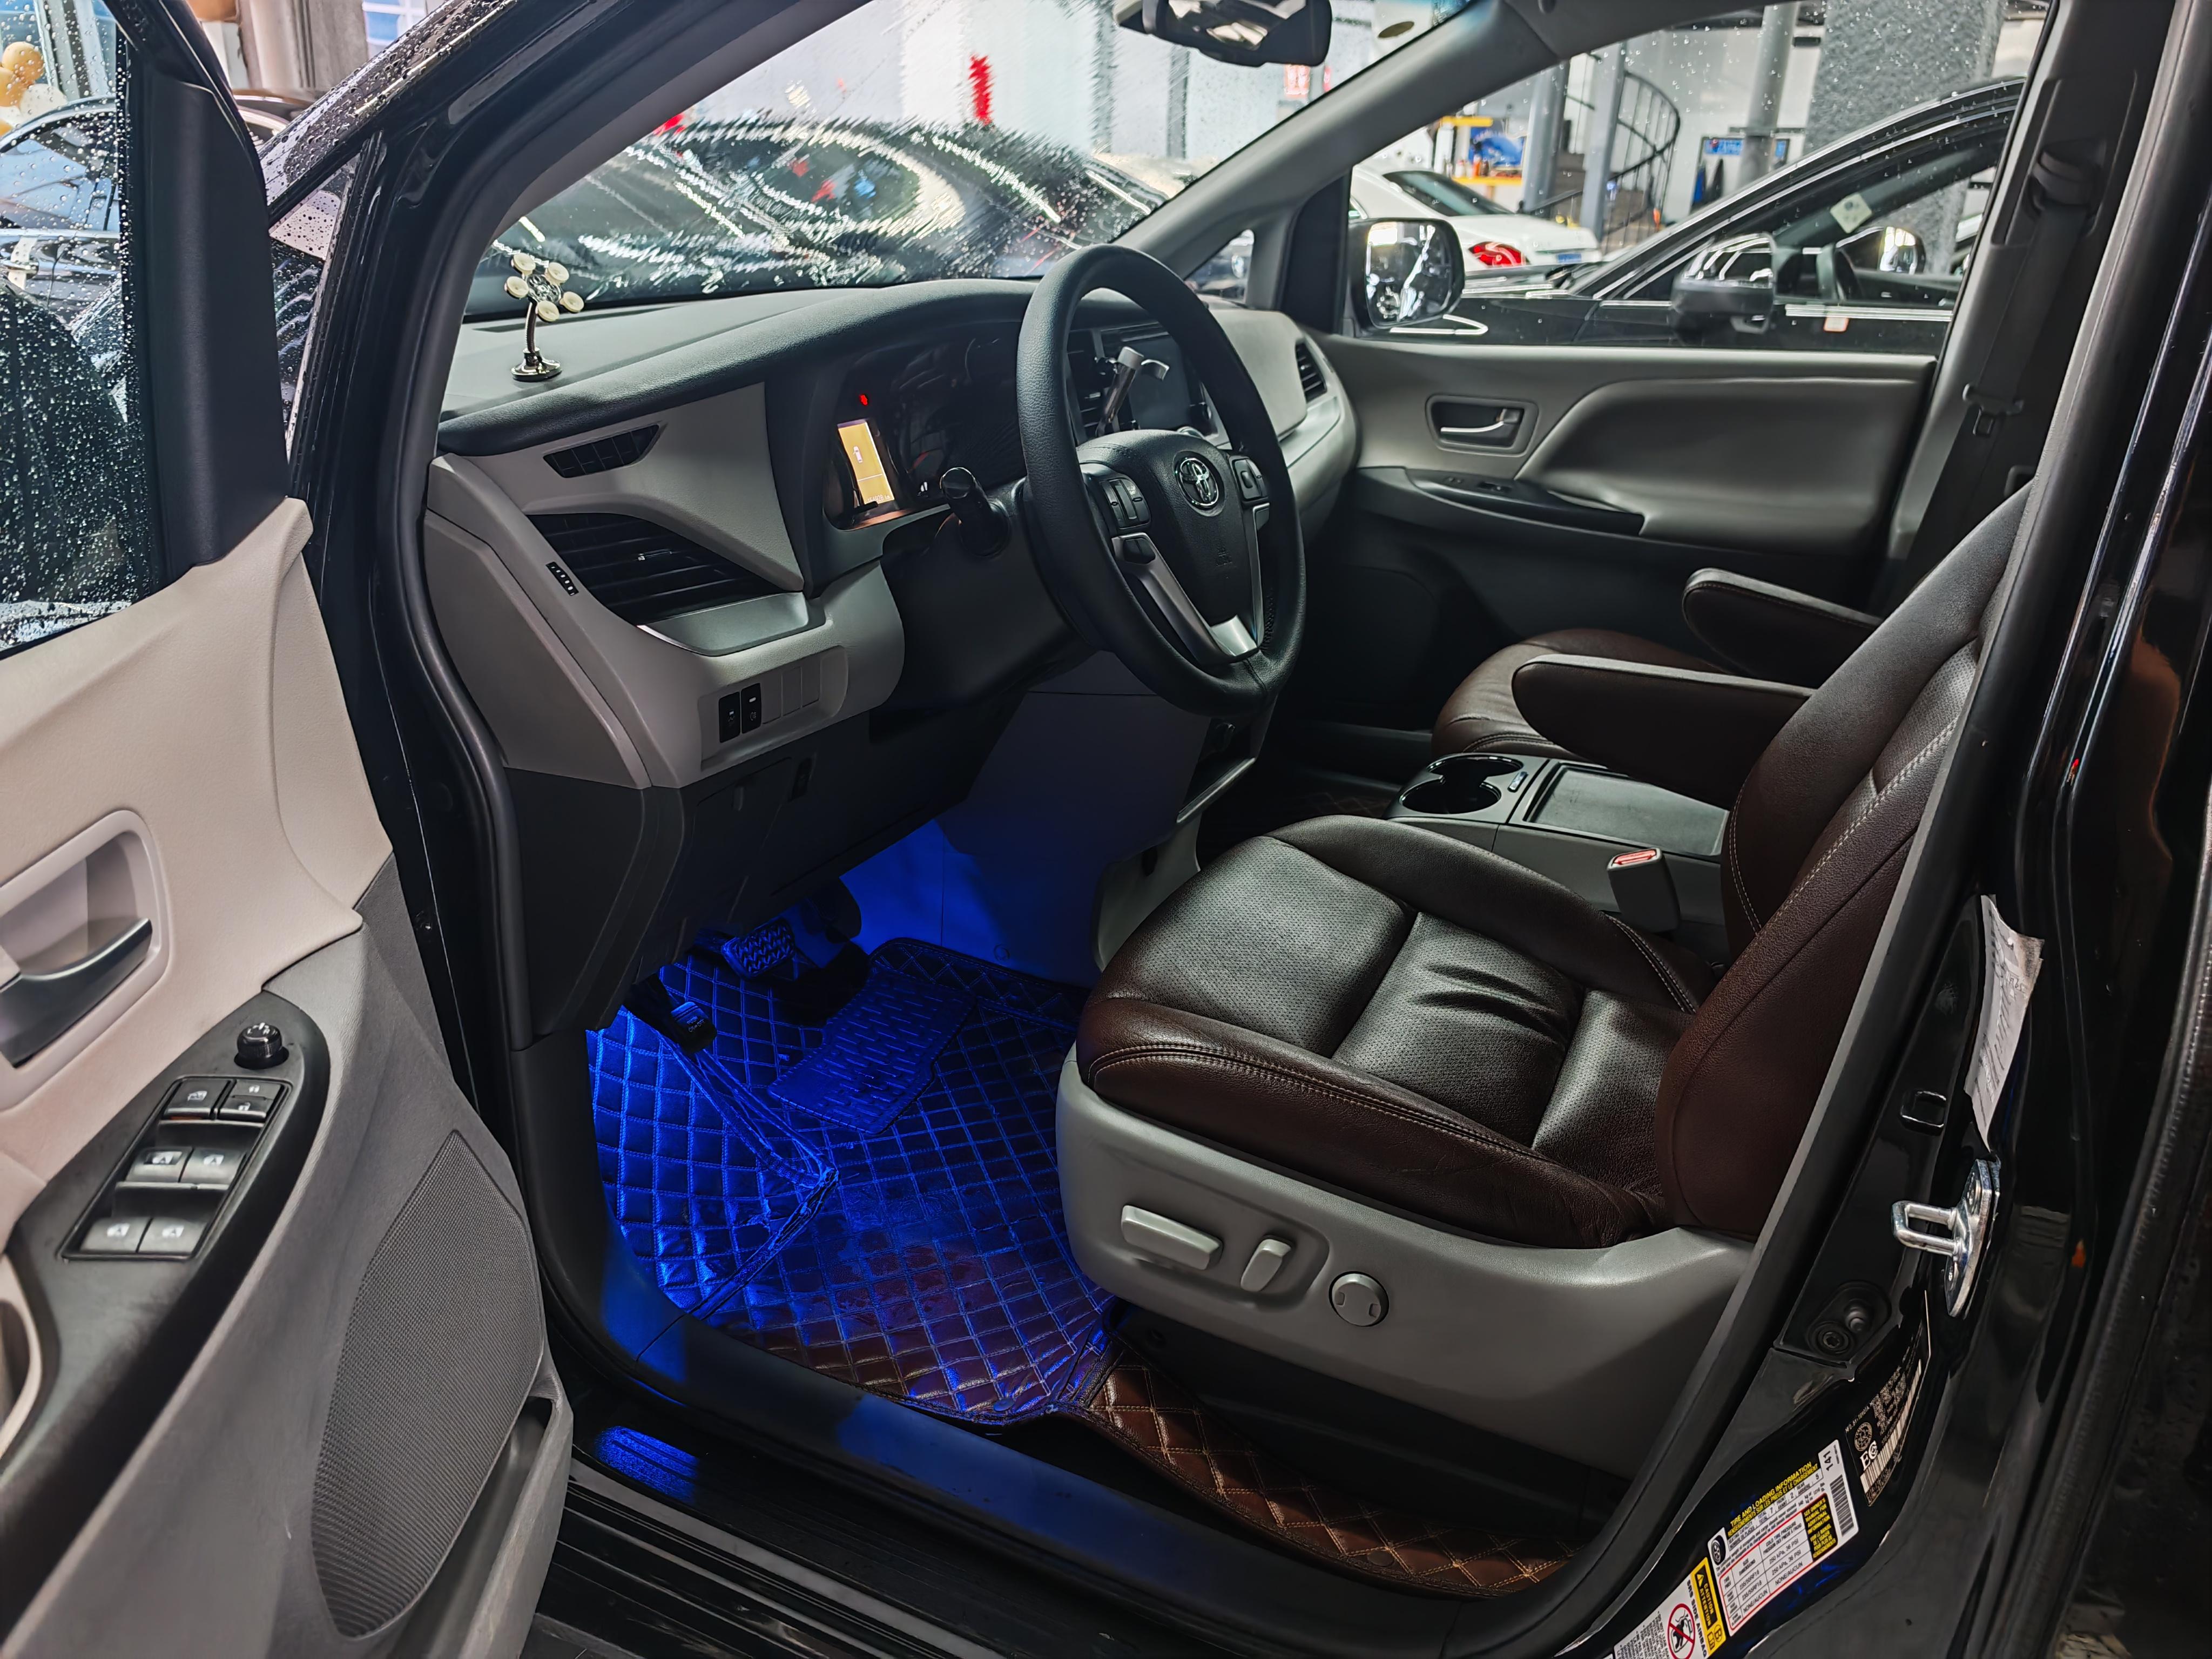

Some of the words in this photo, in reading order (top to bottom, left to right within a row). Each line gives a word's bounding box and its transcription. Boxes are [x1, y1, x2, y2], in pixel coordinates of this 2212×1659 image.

[1823, 1451, 1833, 1471] 141
[1730, 1515, 1741, 1527] TIRE
[1742, 1506, 1752, 1518] AND
[1752, 1489, 1775, 1509] LOADING
[1776, 1462, 1811, 1491] INFORMATION
[1771, 1490, 1783, 1502] PNEUS
[1793, 1464, 1817, 1486] CHARGEMENT
[1805, 1510, 1819, 1522] MANUAL
[1811, 1498, 1825, 1512] OWNER'S
[1781, 1521, 1796, 1534] PRESSURE
[1808, 1511, 1827, 1527] ADDITIONAL
[1808, 1515, 1830, 1534] INFORMATION
[1704, 1583, 1714, 1614] CAUTION
[1743, 1590, 1768, 1613] NONE/AUCUN
[1775, 1562, 1803, 1585] NONE/AUCUN
[1700, 1588, 1711, 1626] ATTENTION
[1696, 1623, 1707, 1657] AIRBAG
